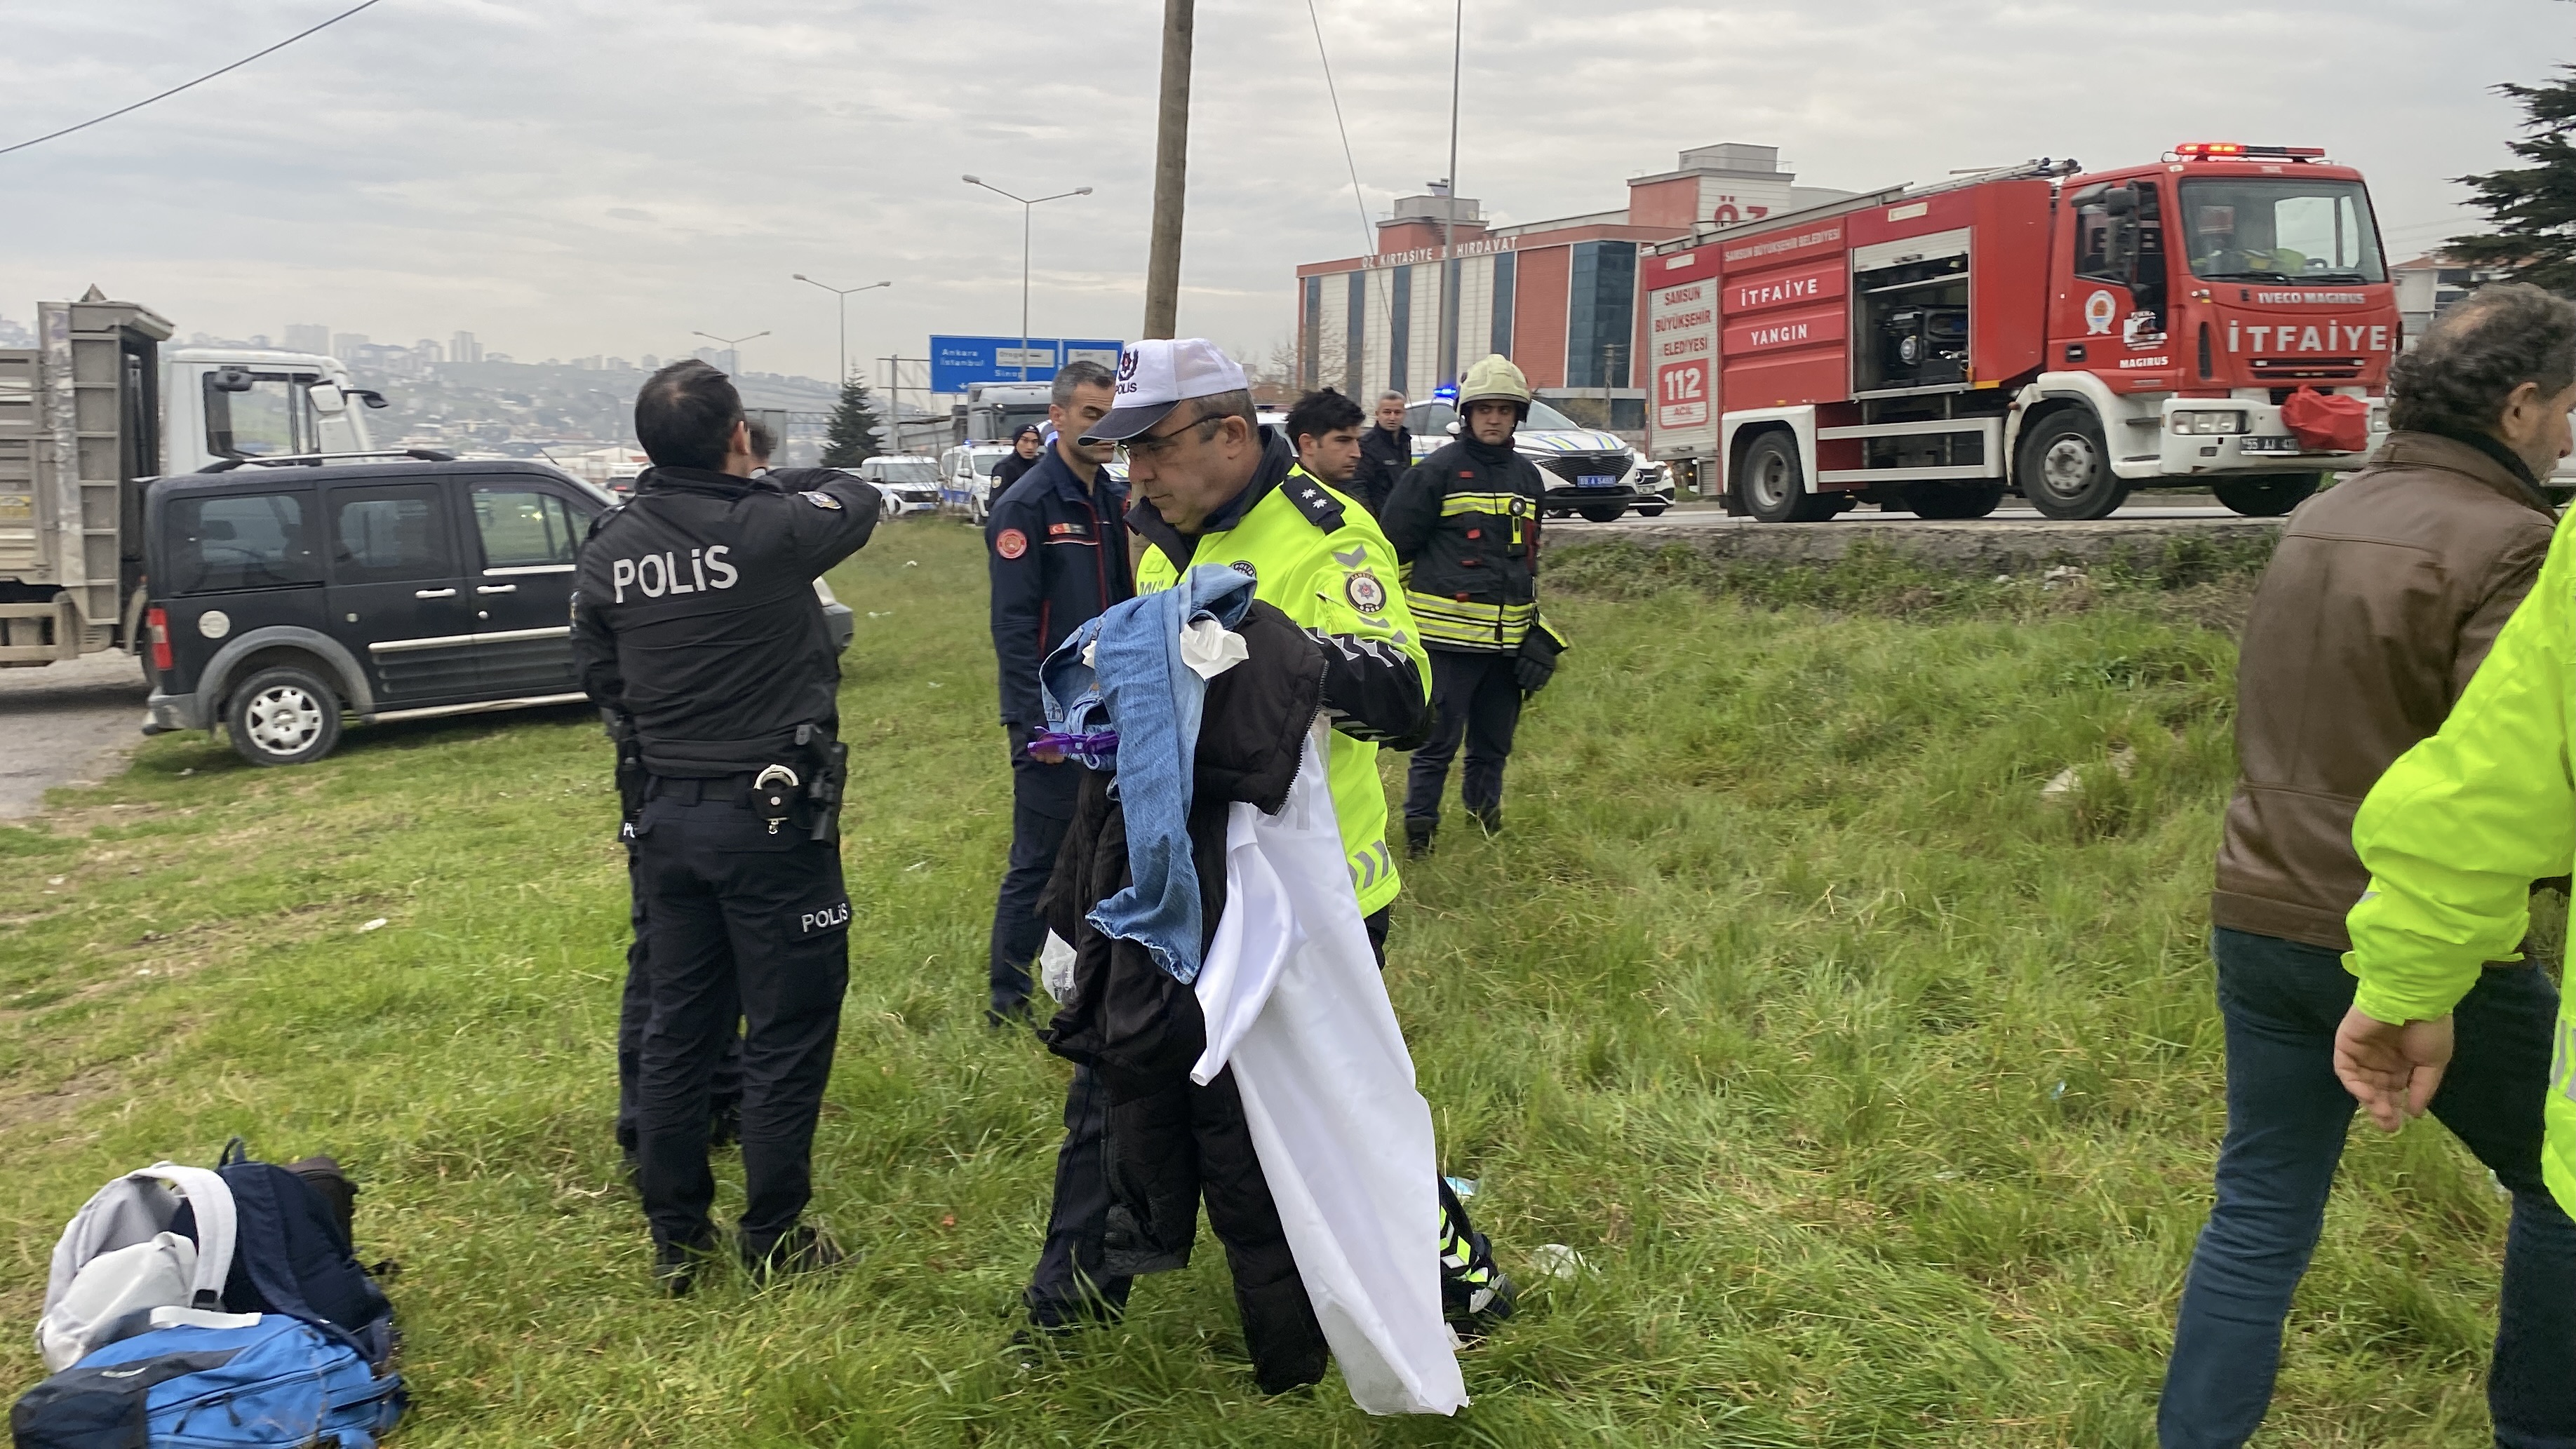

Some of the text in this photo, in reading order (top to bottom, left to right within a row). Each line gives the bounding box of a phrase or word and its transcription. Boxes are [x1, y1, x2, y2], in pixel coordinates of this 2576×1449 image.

[1456, 236, 1517, 257] HIRDAVAT
[1664, 285, 1701, 306] SAMSUN
[1741, 278, 1818, 306] İTFAİYE
[2258, 292, 2302, 304] IVECO
[1750, 323, 1808, 346] YANGIN
[2228, 318, 2389, 353] İTFAİYE
[2119, 356, 2169, 369] MAGIRUS
[1664, 367, 1703, 401] 112
[614, 545, 738, 604] POLİS
[801, 903, 848, 933] POLİS
